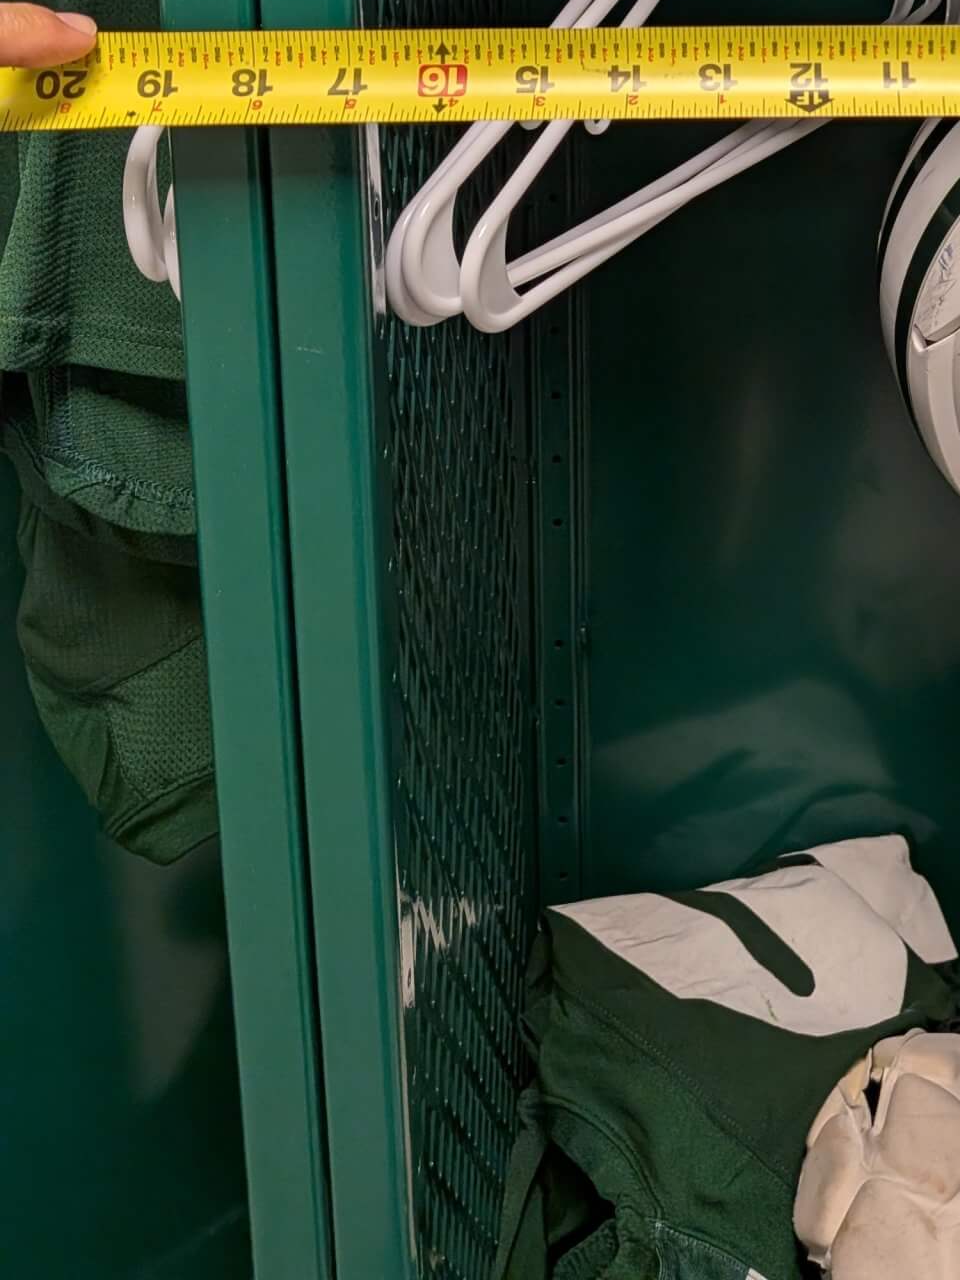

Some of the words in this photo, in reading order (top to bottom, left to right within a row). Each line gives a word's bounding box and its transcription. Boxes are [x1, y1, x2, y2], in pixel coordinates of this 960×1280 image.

[36, 70, 89, 99] 20
[137, 70, 178, 98] 19
[231, 68, 273, 97] 18
[327, 68, 368, 96] 17
[421, 67, 465, 95] 16
[515, 65, 555, 93] 15
[607, 64, 648, 93] 14
[698, 63, 738, 91] 13
[789, 63, 829, 89] 12
[882, 61, 916, 88] 11
[60, 103, 72, 113] 8
[153, 101, 163, 112] 7
[251, 99, 263, 110] 6
[345, 98, 357, 109] 5
[448, 97, 459, 108] 4
[535, 95, 546, 106] 3
[628, 95, 639, 105] 2
[719, 94, 727, 104] 1
